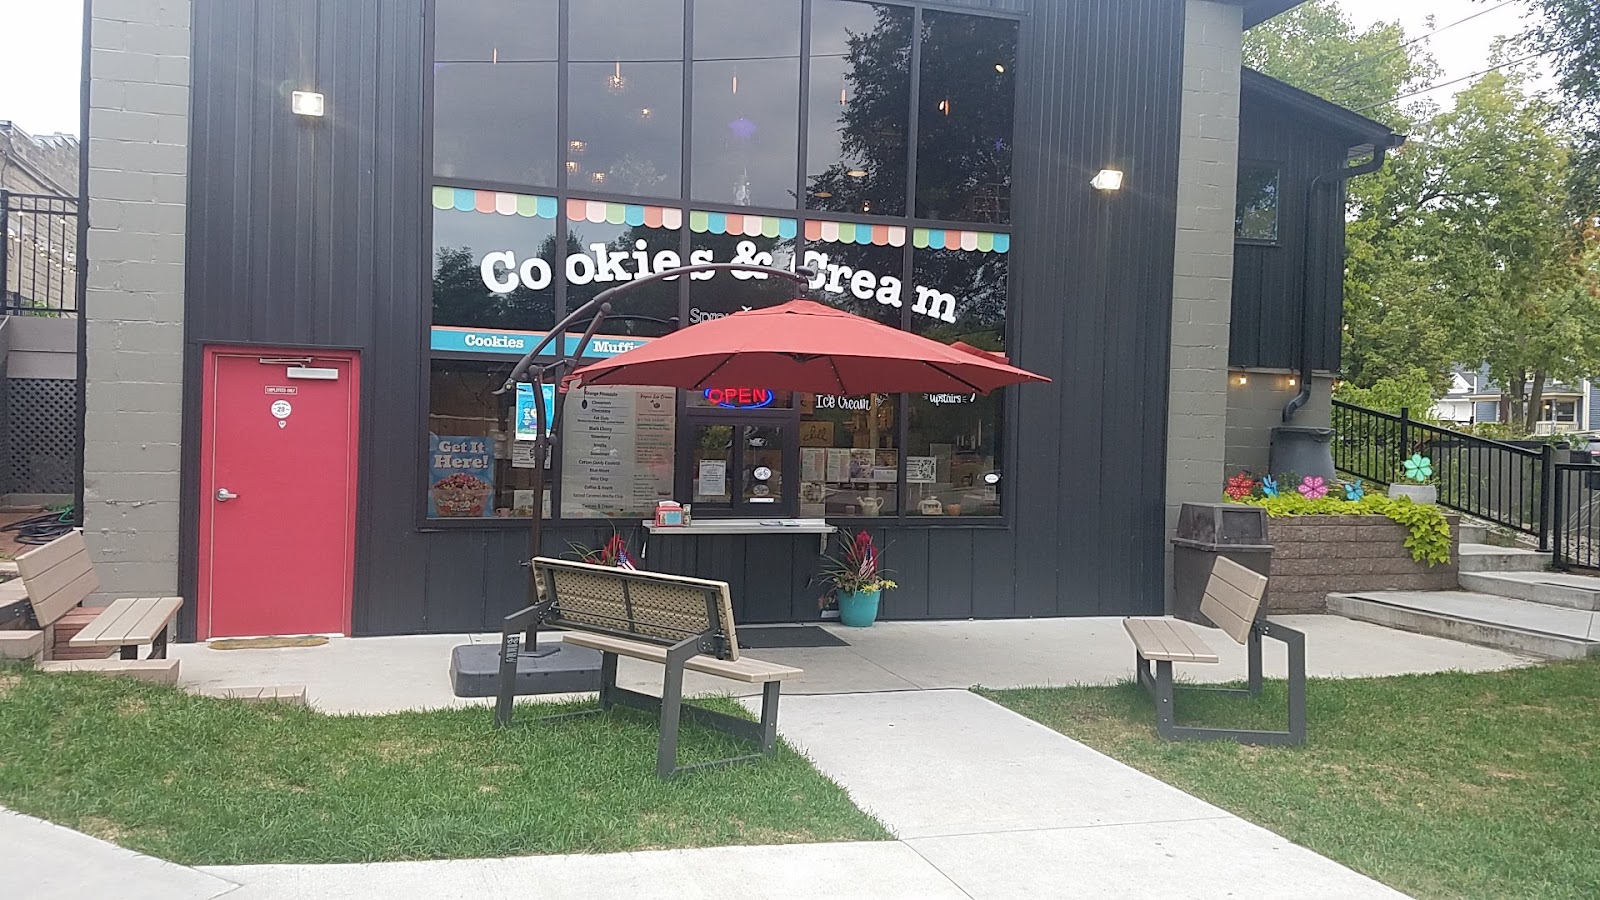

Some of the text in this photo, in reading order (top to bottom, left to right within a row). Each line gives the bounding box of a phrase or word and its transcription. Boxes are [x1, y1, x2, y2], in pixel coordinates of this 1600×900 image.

[480, 238, 957, 324] Cookies & Cream
[464, 334, 524, 348] Cookies
[708, 387, 767, 406] OPEN
[815, 394, 836, 409] Ice
[439, 441, 485, 453] Get It
[434, 454, 489, 469] Here!
